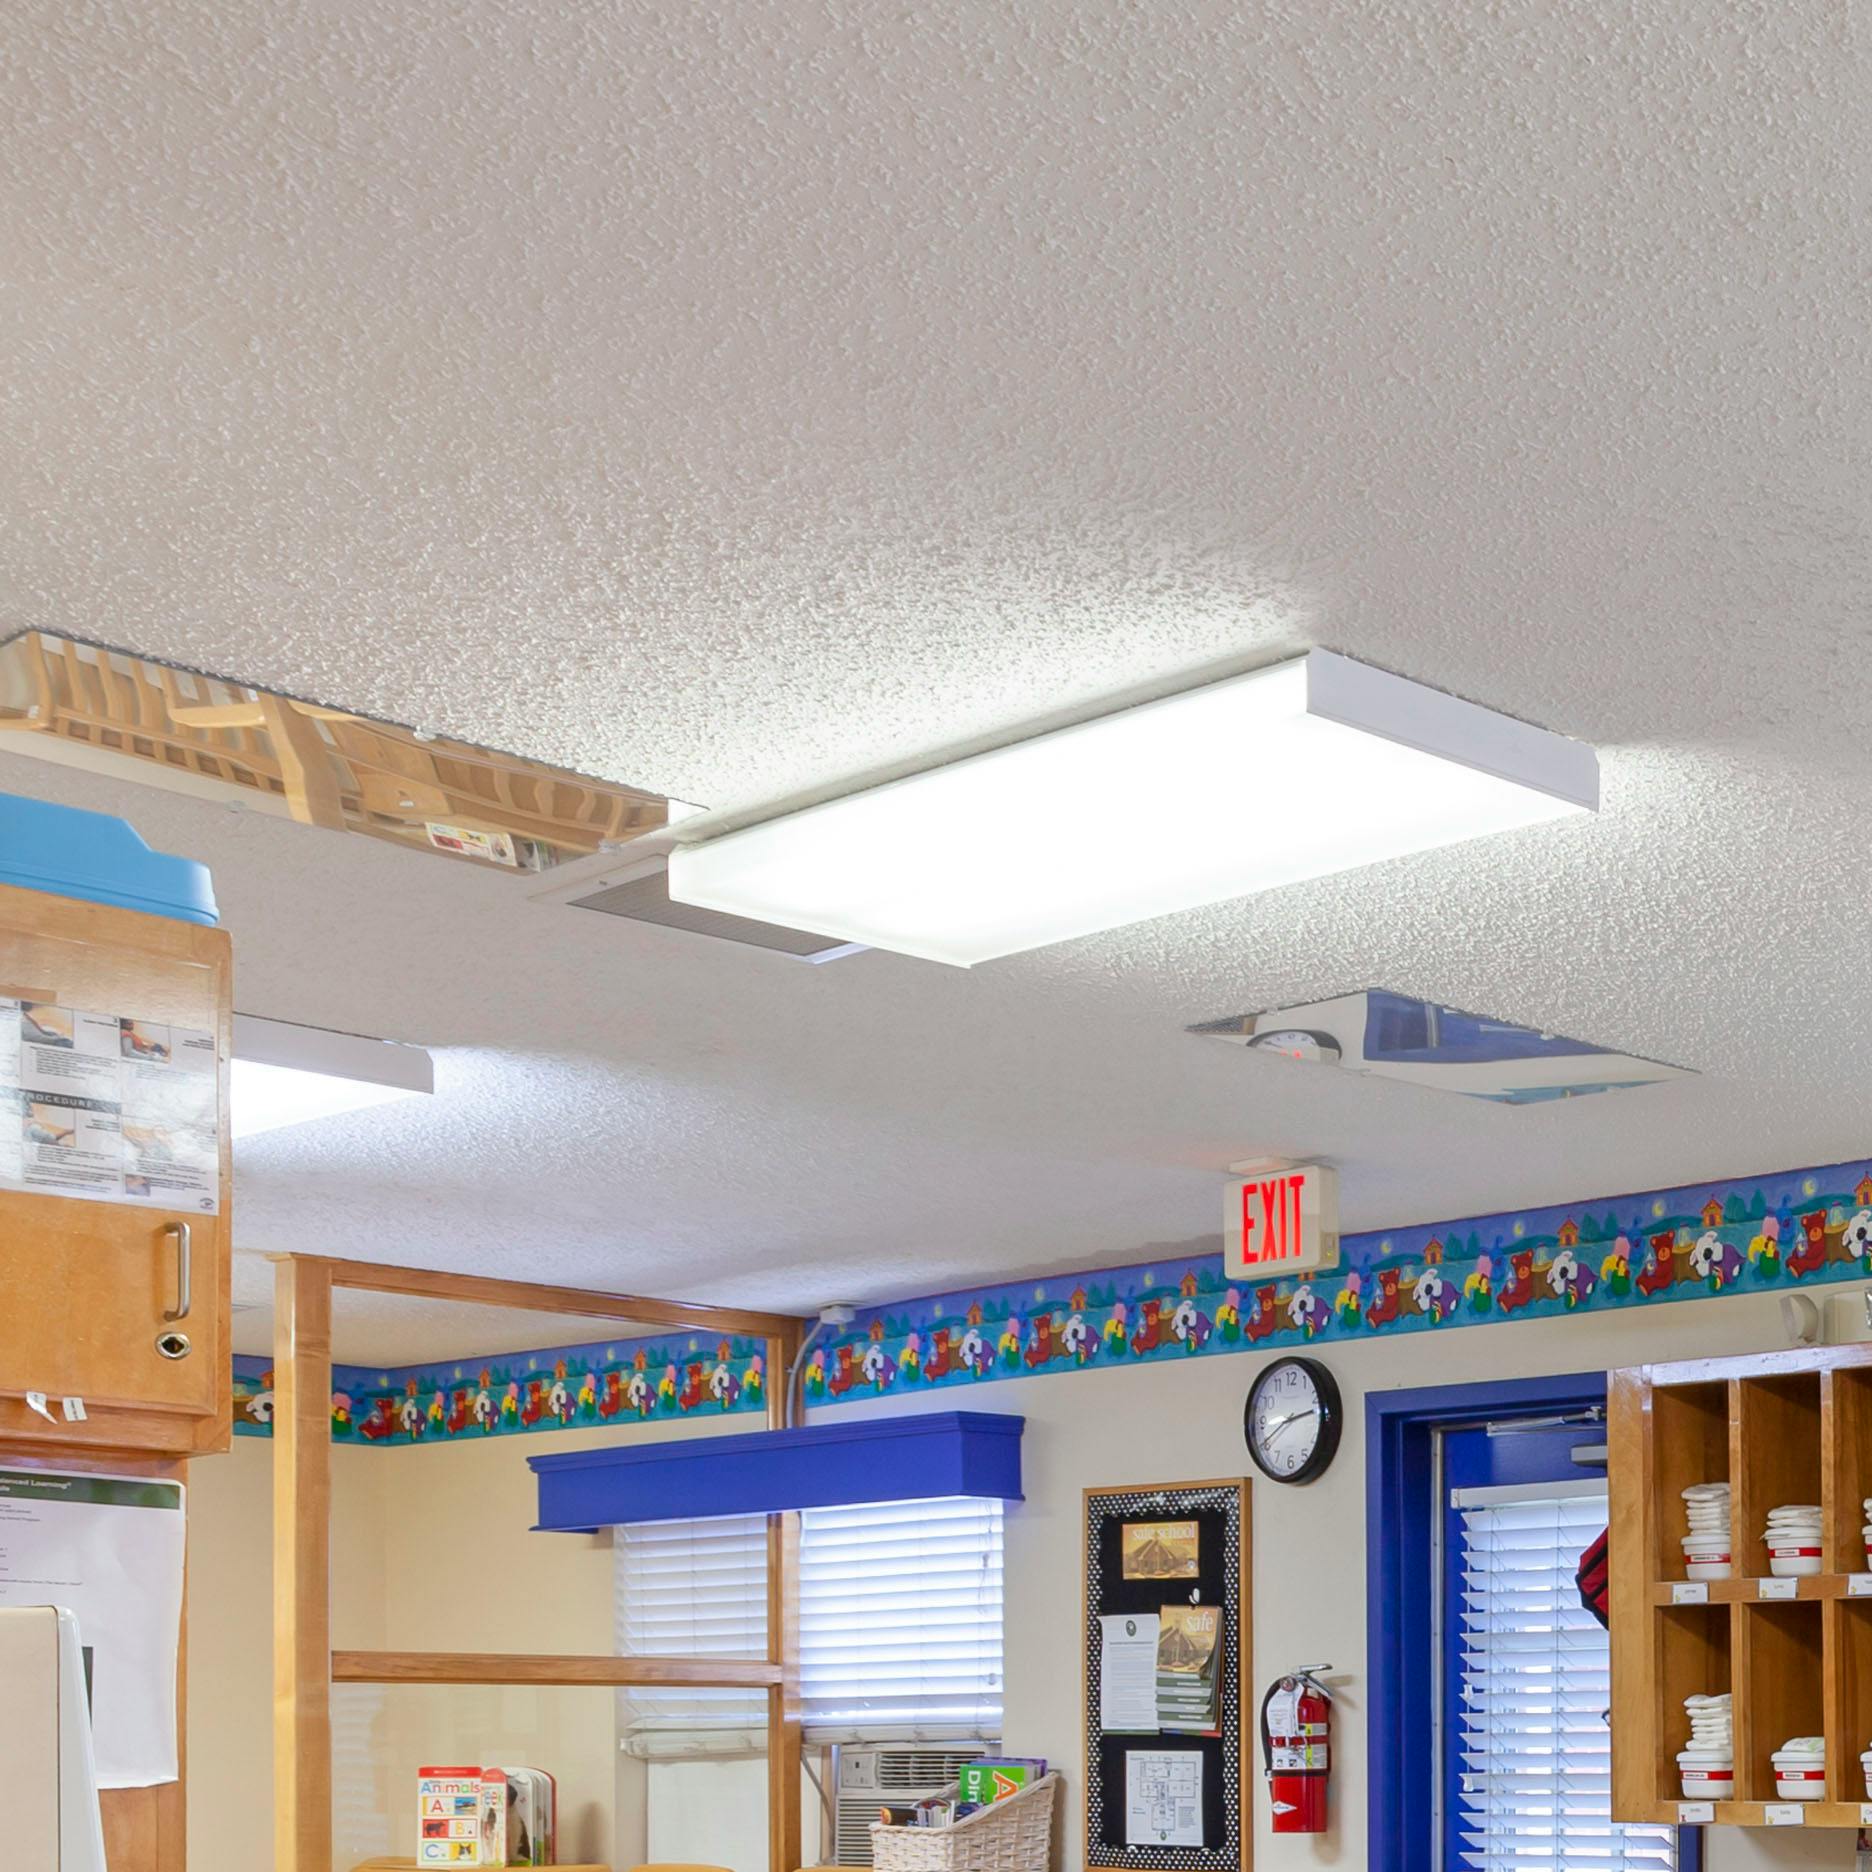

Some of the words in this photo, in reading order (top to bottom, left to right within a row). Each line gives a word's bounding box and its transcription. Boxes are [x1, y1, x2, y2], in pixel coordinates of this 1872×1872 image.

[1242, 1175, 1304, 1264] EXIT
[1274, 1378, 1282, 1393] 11
[1286, 1371, 1297, 1386] 12
[1303, 1375, 1307, 1389] 1
[1263, 1396, 1275, 1410] 10
[1274, 1450, 1280, 1464] 7
[1287, 1455, 1295, 1469] 6
[1157, 1523, 1195, 1539] school
[1186, 1612, 1213, 1633] safe
[420, 1782, 480, 1794] Animals
[993, 1770, 1019, 1801] A
[432, 1799, 444, 1813] A
[455, 1822, 464, 1835] B
[425, 1843, 439, 1858] C
